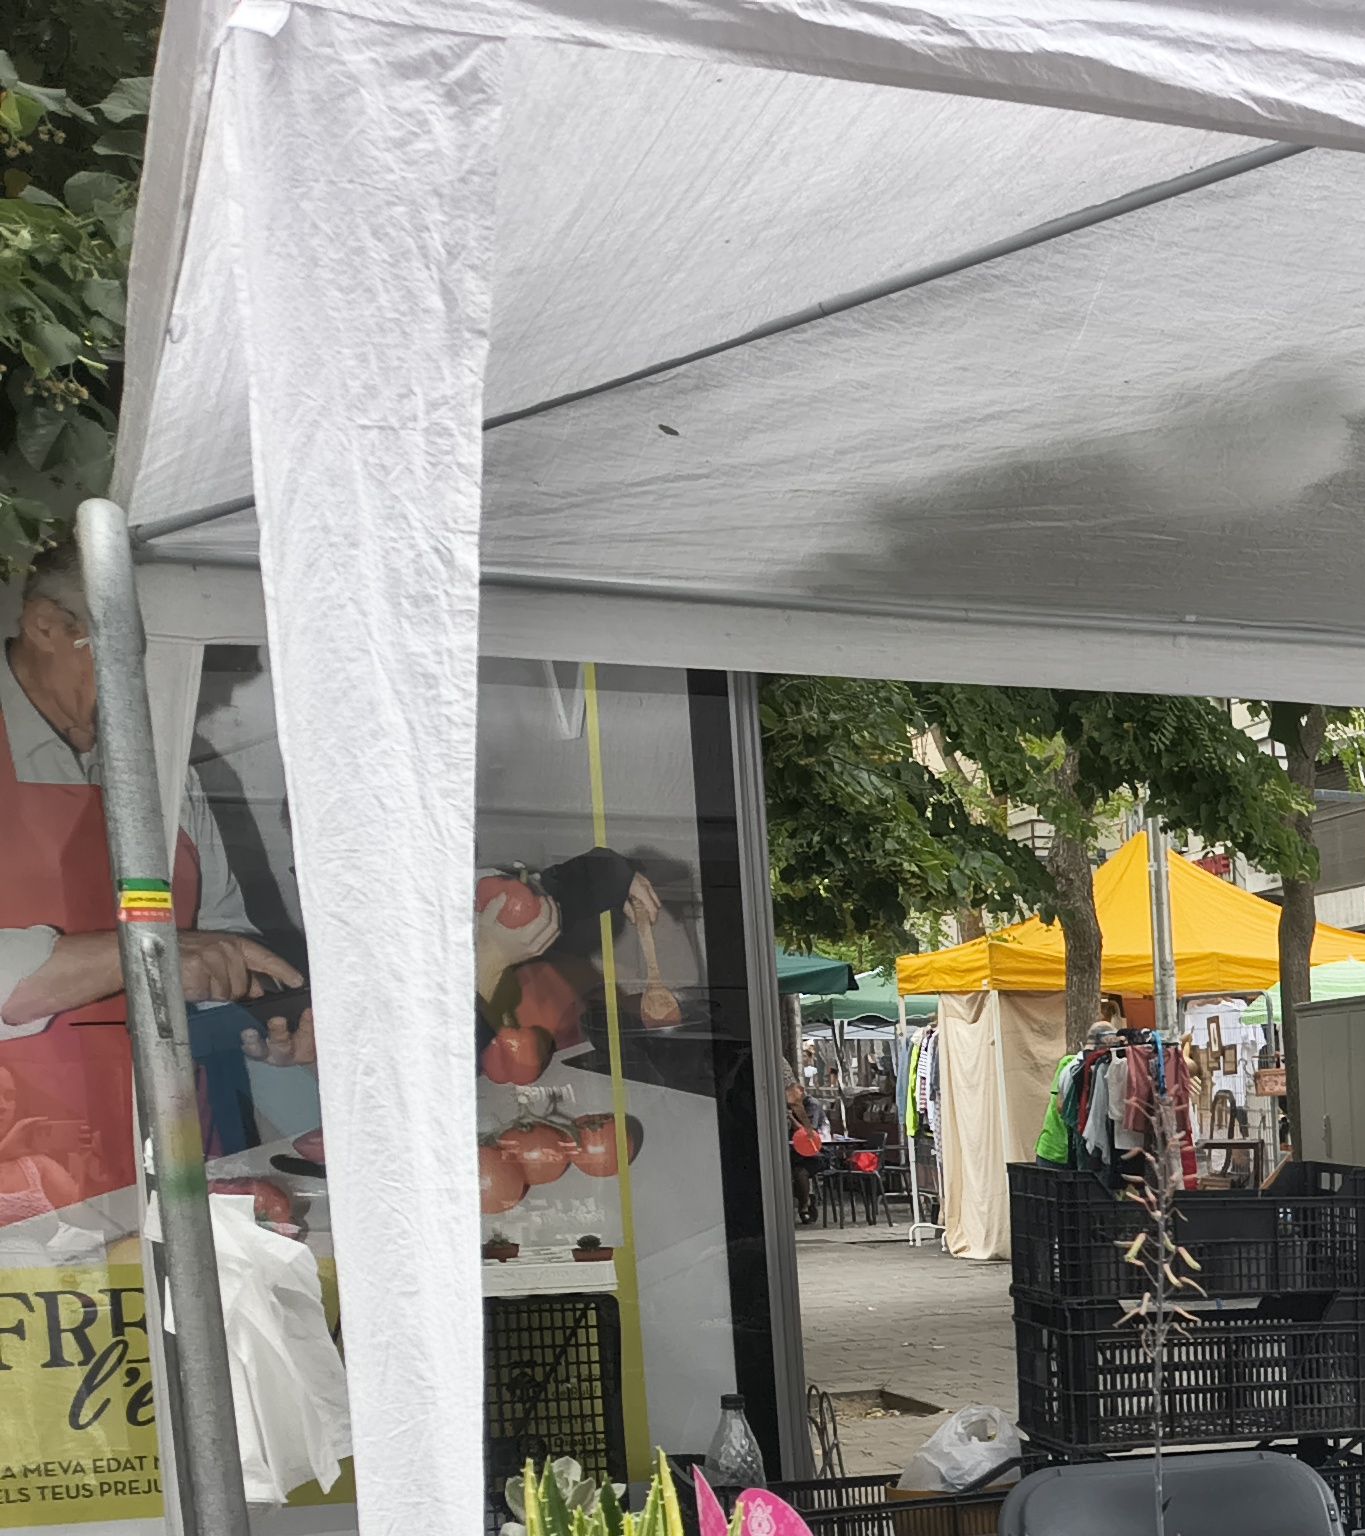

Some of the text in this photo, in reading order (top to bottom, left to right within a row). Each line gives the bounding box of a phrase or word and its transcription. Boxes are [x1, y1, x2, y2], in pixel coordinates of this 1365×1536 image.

[22, 1460, 86, 1479] MEVA
[92, 1455, 148, 1474] EDAT
[36, 1483, 94, 1501] TEUS
